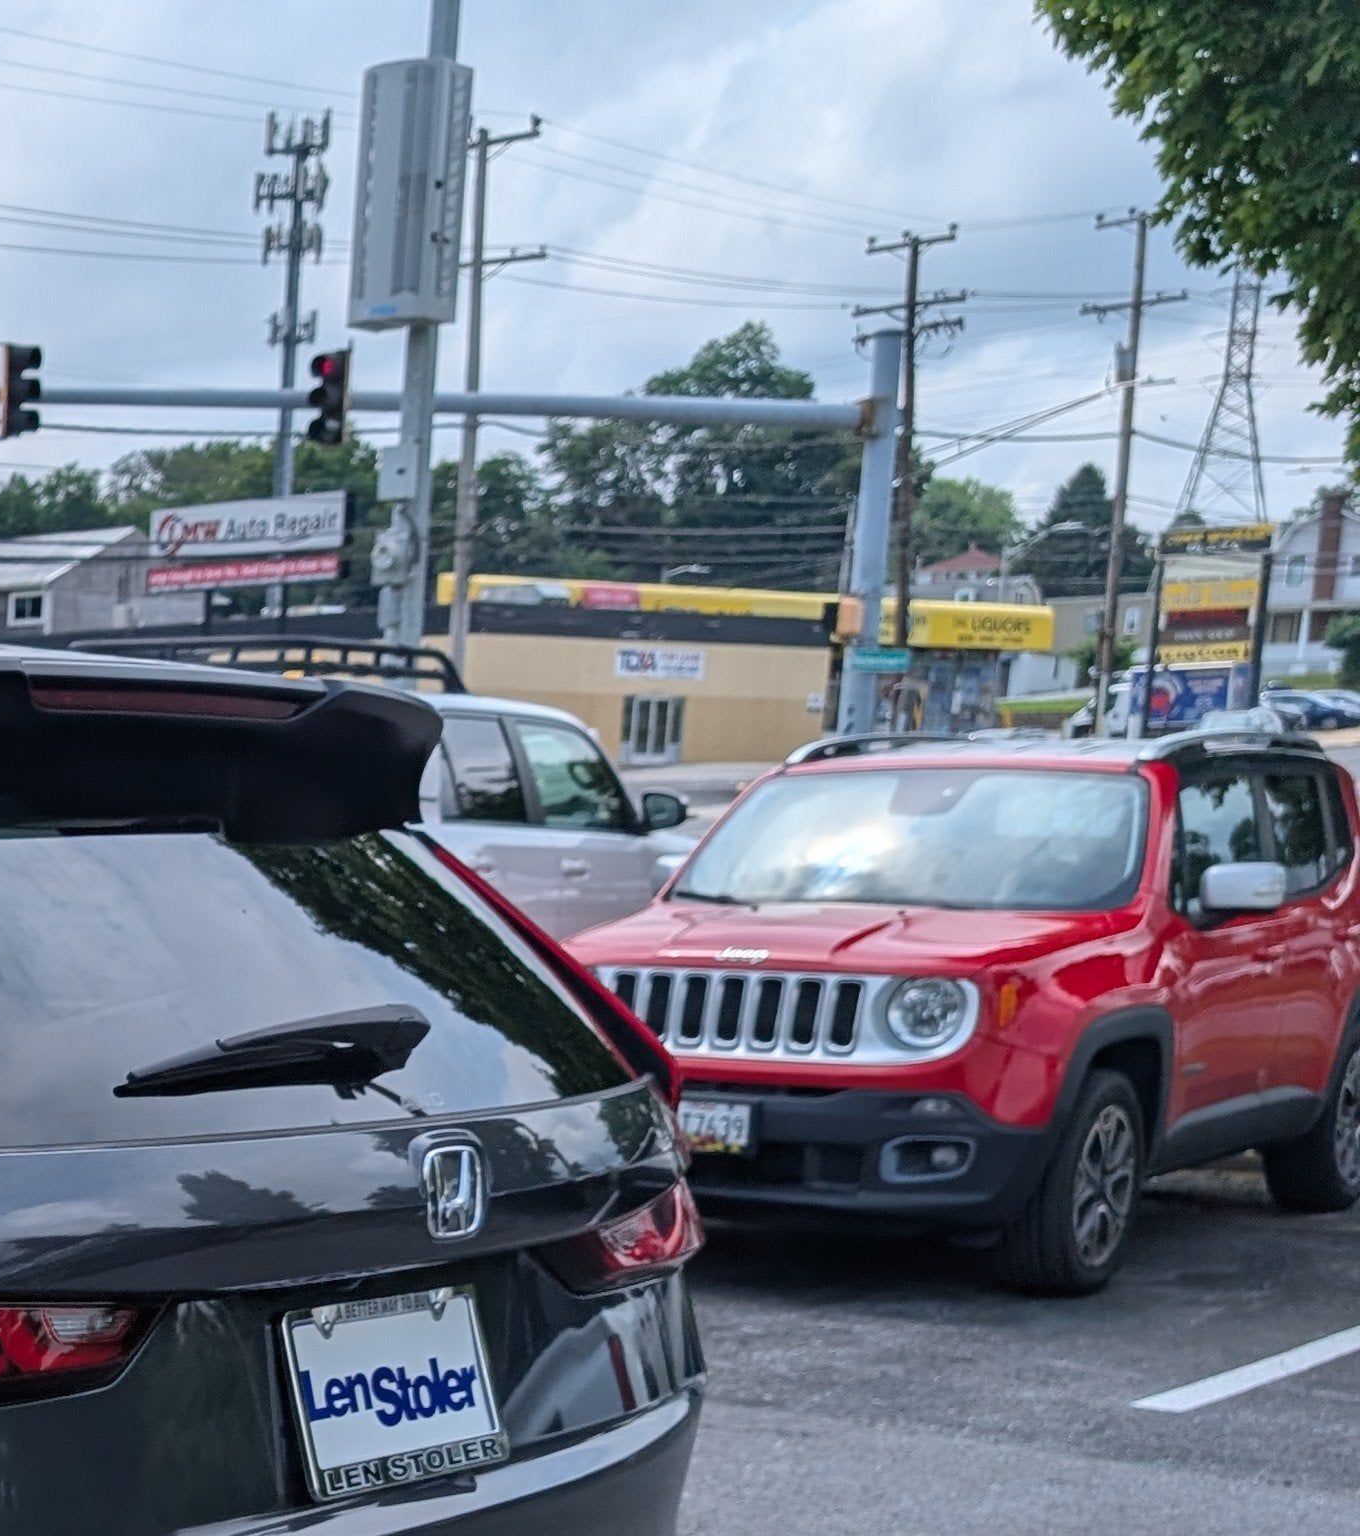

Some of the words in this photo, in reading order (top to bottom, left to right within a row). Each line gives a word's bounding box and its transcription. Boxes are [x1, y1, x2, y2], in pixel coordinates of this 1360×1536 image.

[225, 517, 268, 539] Auto
[273, 509, 339, 536] Repair
[682, 1111, 745, 1140] T7639
[326, 1464, 383, 1495] LEN
[389, 1437, 501, 1479] STOLER
